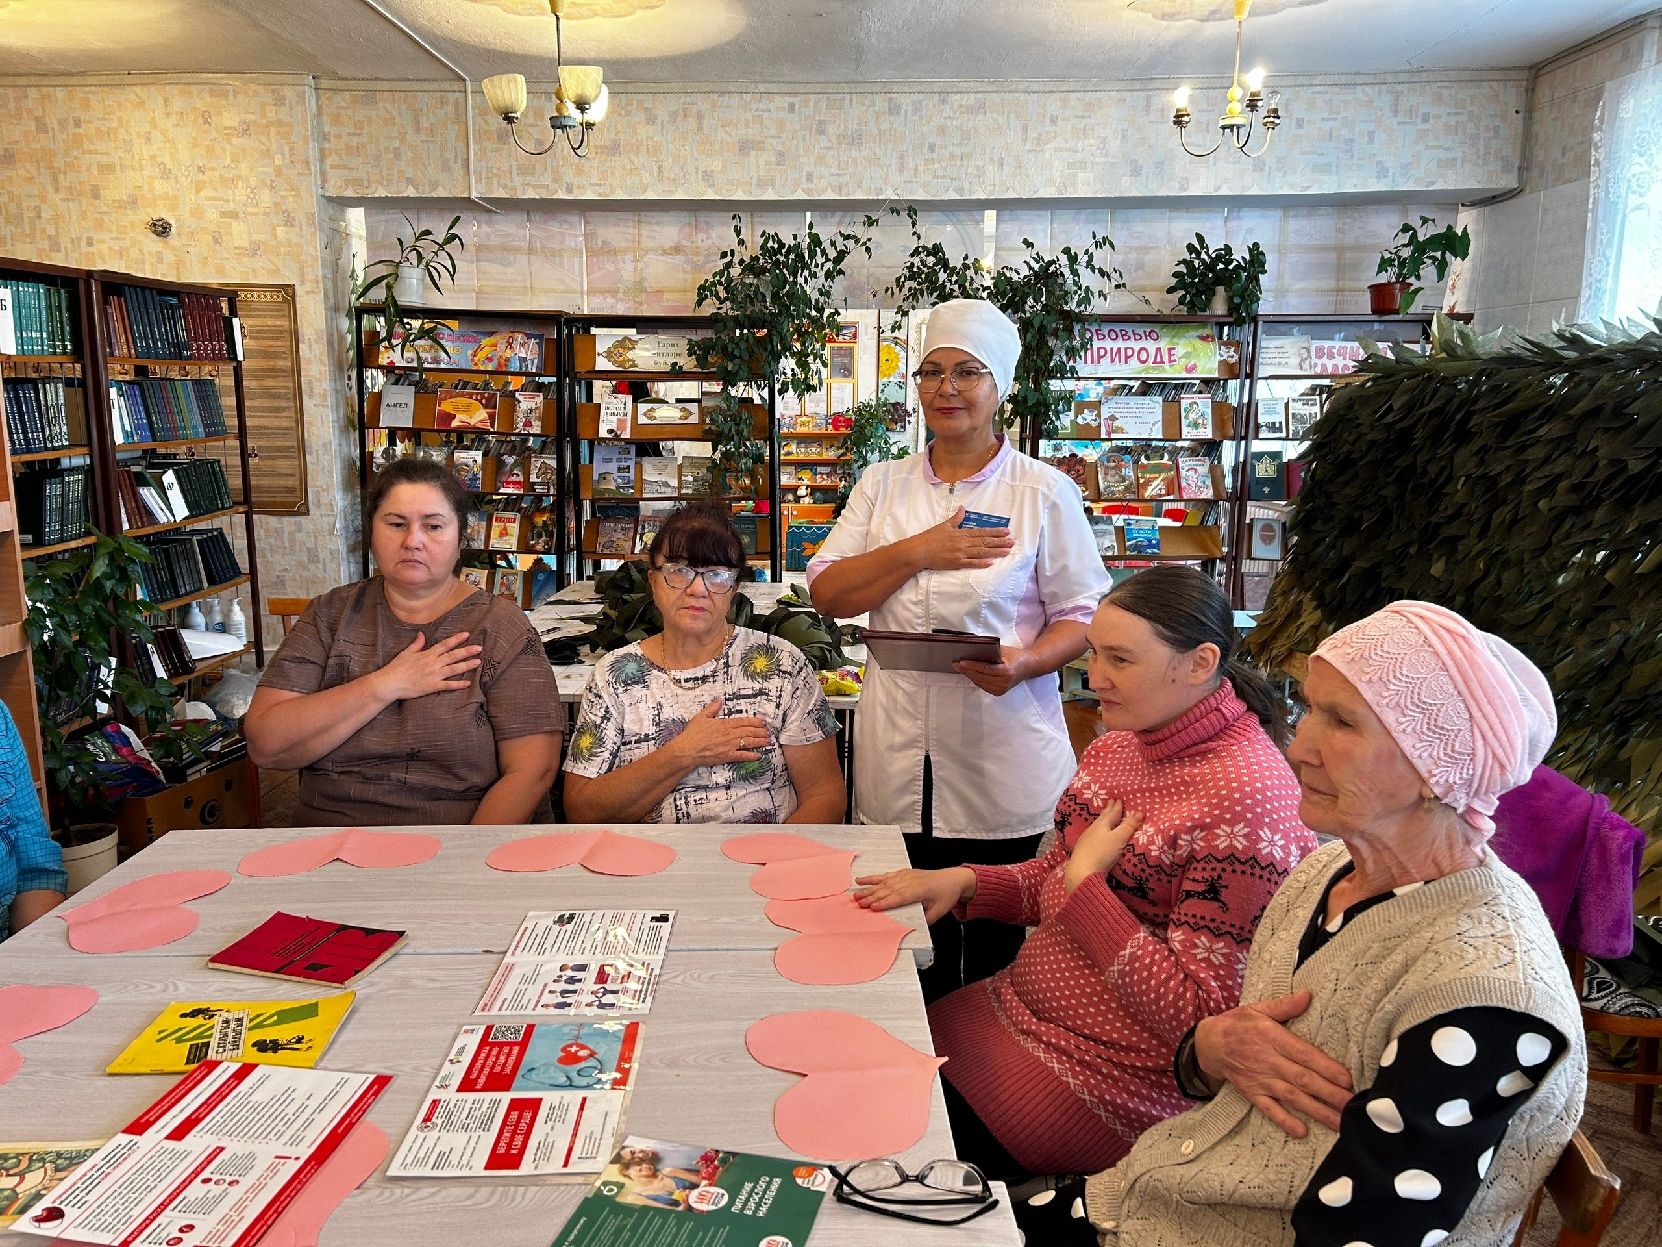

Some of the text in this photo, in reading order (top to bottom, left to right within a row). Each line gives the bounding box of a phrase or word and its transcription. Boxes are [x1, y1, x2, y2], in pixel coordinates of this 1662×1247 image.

[1083, 346, 1178, 365] ПРИРОДЕ
[496, 1110, 520, 1154] БЕРЕГИТЕ СЕБЯ
[731, 1181, 755, 1214] ПИТАНИЕ
[743, 1175, 770, 1216] ВЗРОСЛОГО
[755, 1177, 783, 1217] НАСЕЛЕНИЯ
